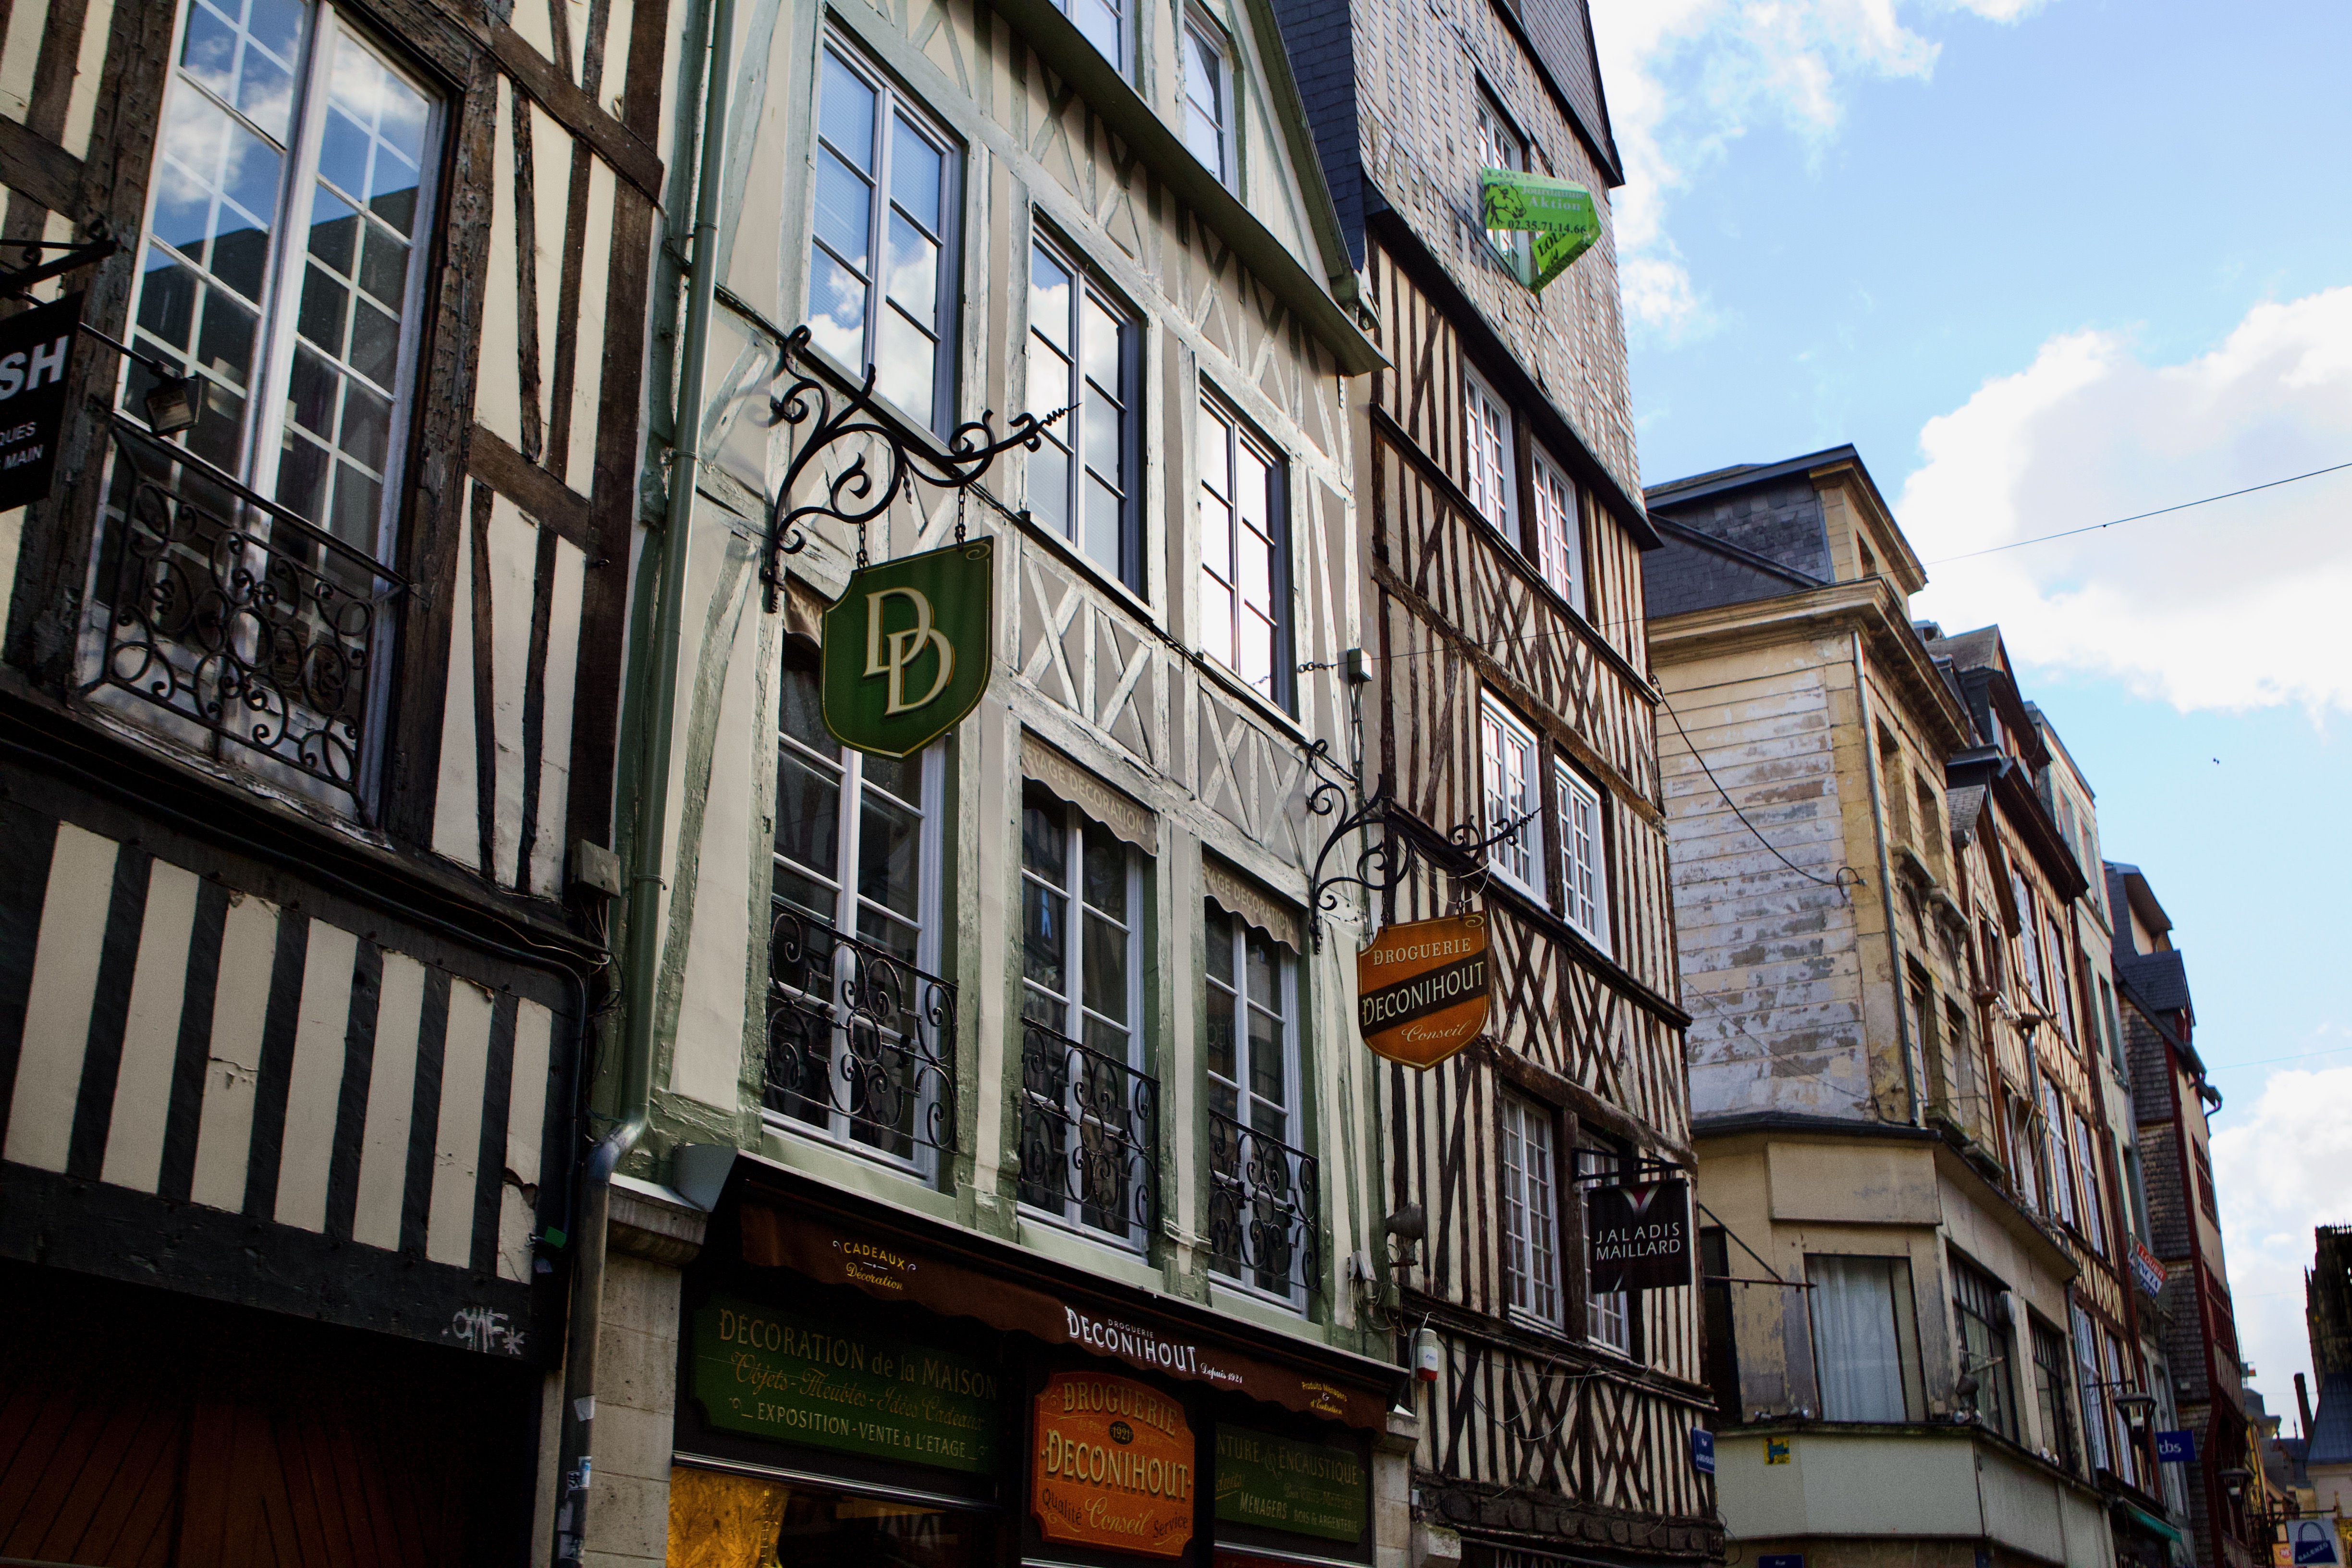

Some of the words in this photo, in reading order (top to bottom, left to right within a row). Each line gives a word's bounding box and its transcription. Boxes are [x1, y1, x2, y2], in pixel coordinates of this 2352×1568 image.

[1529, 195, 1580, 211] Aktion
[1507, 220, 1587, 235] 02.35.71.14.66
[3, 443, 44, 470] MAIN
[1373, 938, 1471, 966] DROGUERIE
[1362, 961, 1484, 1026] DECONIHOUT
[1402, 1019, 1471, 1042] Conseil
[1596, 1222, 1679, 1245] JALADIS
[844, 1242, 905, 1270] CADEAUX
[1596, 1238, 1680, 1261] MAILLARD
[846, 1262, 904, 1290] Décoration
[1107, 1318, 1154, 1338] DROGUERIE
[1065, 1306, 1197, 1374] DECONIHOUT
[1200, 1362, 1226, 1380] Depuis
[1227, 1372, 1243, 1384] 1921
[872, 1351, 894, 1378] de
[899, 1354, 914, 1383] la
[922, 1357, 998, 1401] MAISON
[1301, 1381, 1322, 1391] Produits
[730, 1351, 788, 1396] Objets
[799, 1368, 867, 1407] Meubles
[921, 1396, 984, 1432] Cadeaux
[1063, 1381, 1178, 1437] DROGUERIE
[757, 1402, 850, 1436] EXPOSITION
[858, 1421, 900, 1446] VENTE
[1112, 1426, 1131, 1441] 1921
[2159, 1438, 2181, 1455] tbs
[1046, 1428, 1189, 1499] DECONIHOUT
[1278, 1446, 1358, 1486] ENCAUSTIQUE
[1042, 1488, 1082, 1526] Qualité
[1084, 1496, 1154, 1536] Conseil
[1153, 1511, 1188, 1538] Service
[1319, 1514, 1358, 1533] ARGENTERIE
